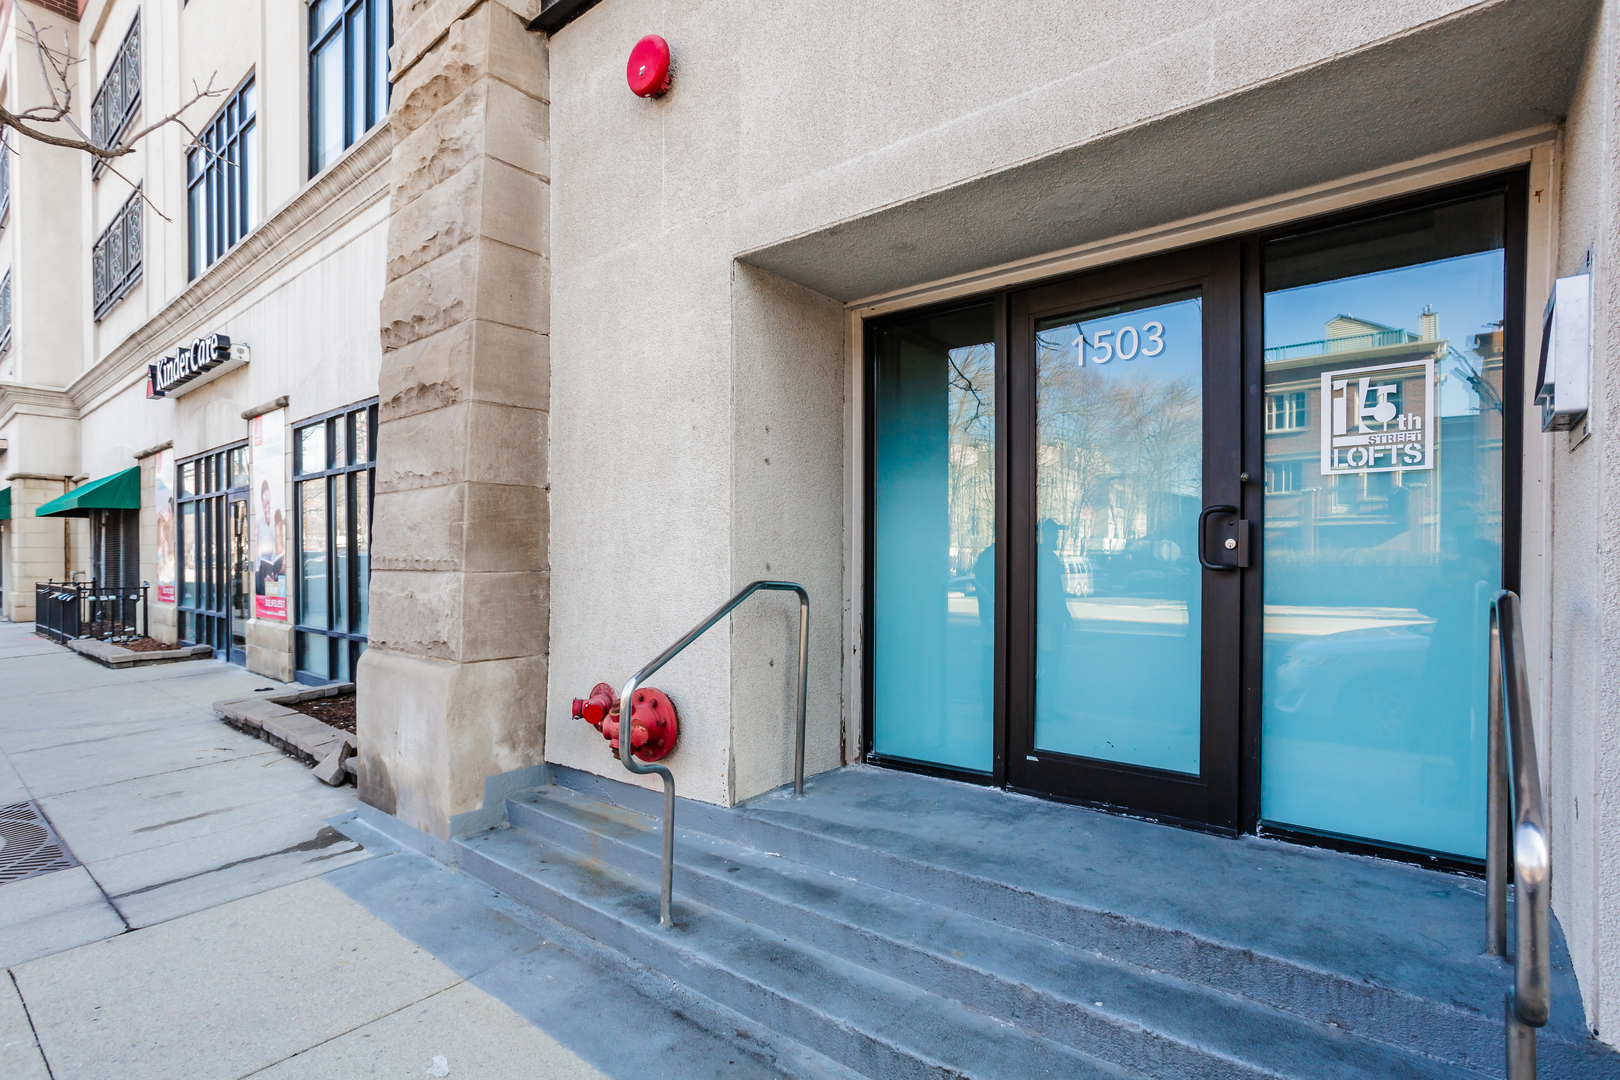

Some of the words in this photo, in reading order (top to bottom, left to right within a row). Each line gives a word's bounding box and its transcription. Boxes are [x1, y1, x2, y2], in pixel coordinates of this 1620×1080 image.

[156, 333, 219, 391] KinderCare
[1071, 321, 1164, 367] 1503
[1333, 377, 1422, 435] 15th
[1333, 443, 1422, 467] LOFTS
[1368, 432, 1422, 445] STREET
